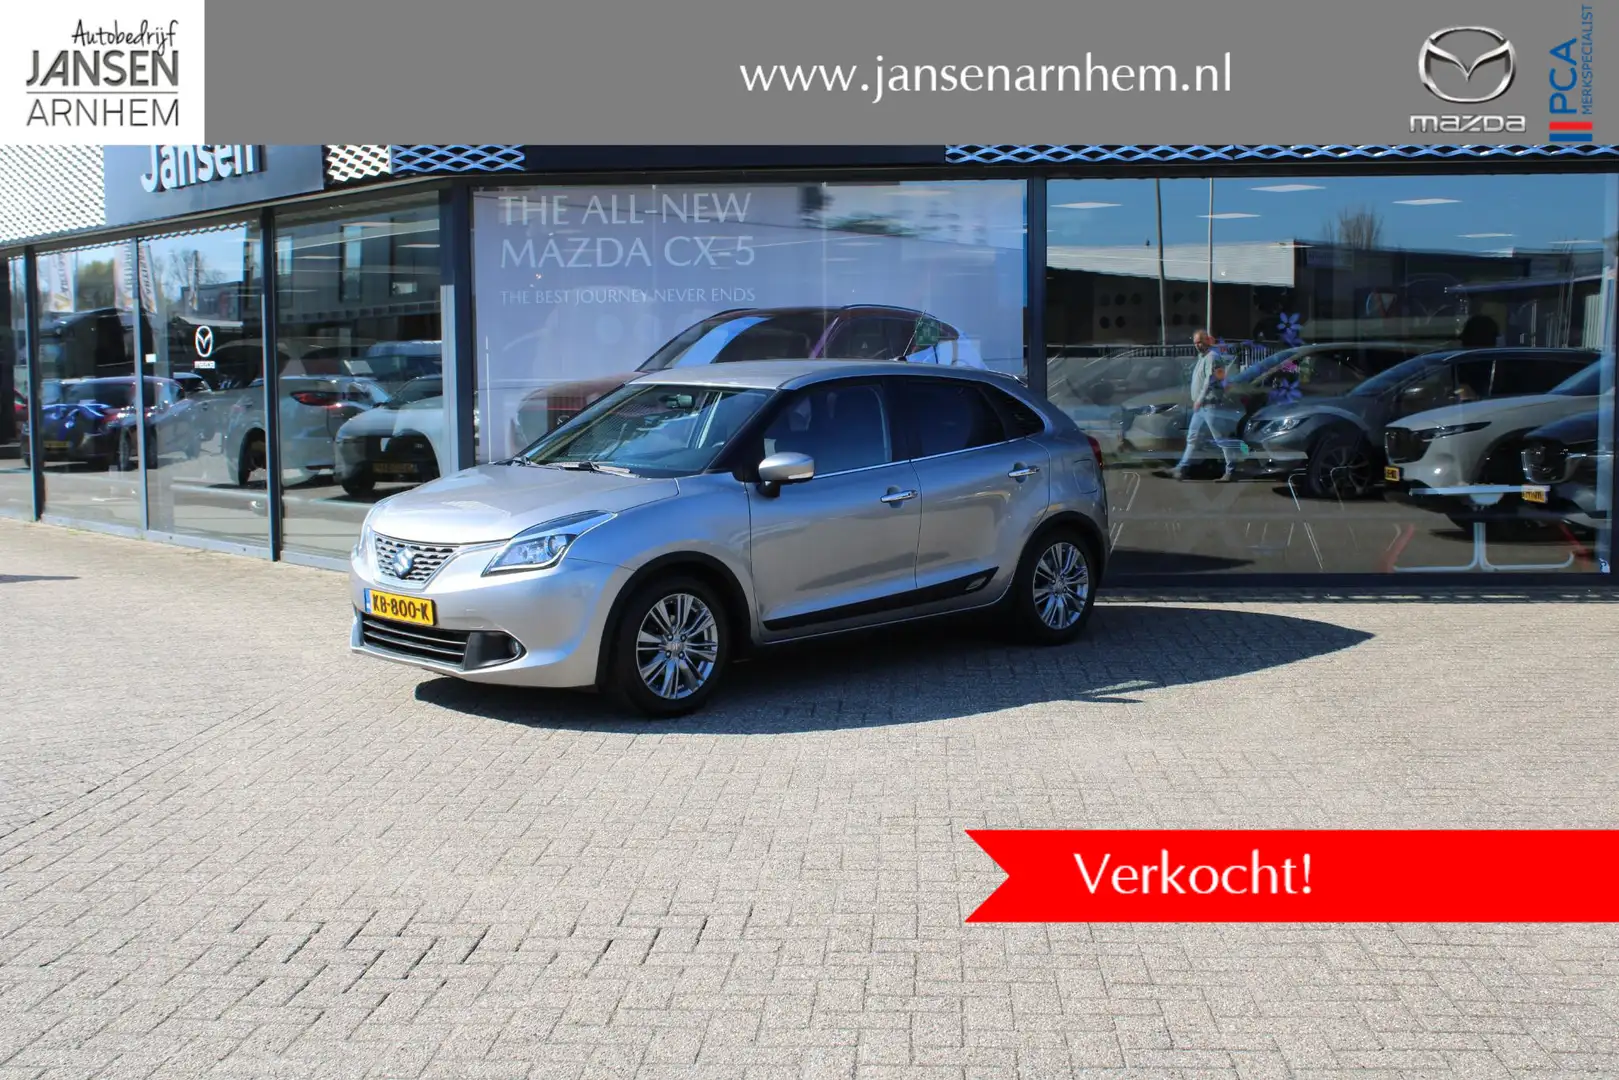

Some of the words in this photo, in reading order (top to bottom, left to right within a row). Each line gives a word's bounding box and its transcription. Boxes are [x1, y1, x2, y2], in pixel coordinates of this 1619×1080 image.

[140, 145, 254, 193] Jansen
[498, 194, 570, 227] THE
[581, 191, 752, 225] ALL-NEW
[500, 236, 652, 269] MAZDA
[664, 235, 755, 267] CX-5
[501, 290, 530, 305] THE
[535, 289, 570, 305] BEST
[573, 287, 648, 306] JOURNEY
[654, 287, 705, 303] NEVER
[711, 286, 756, 303] ENDS
[372, 592, 430, 622] KB-800-K
